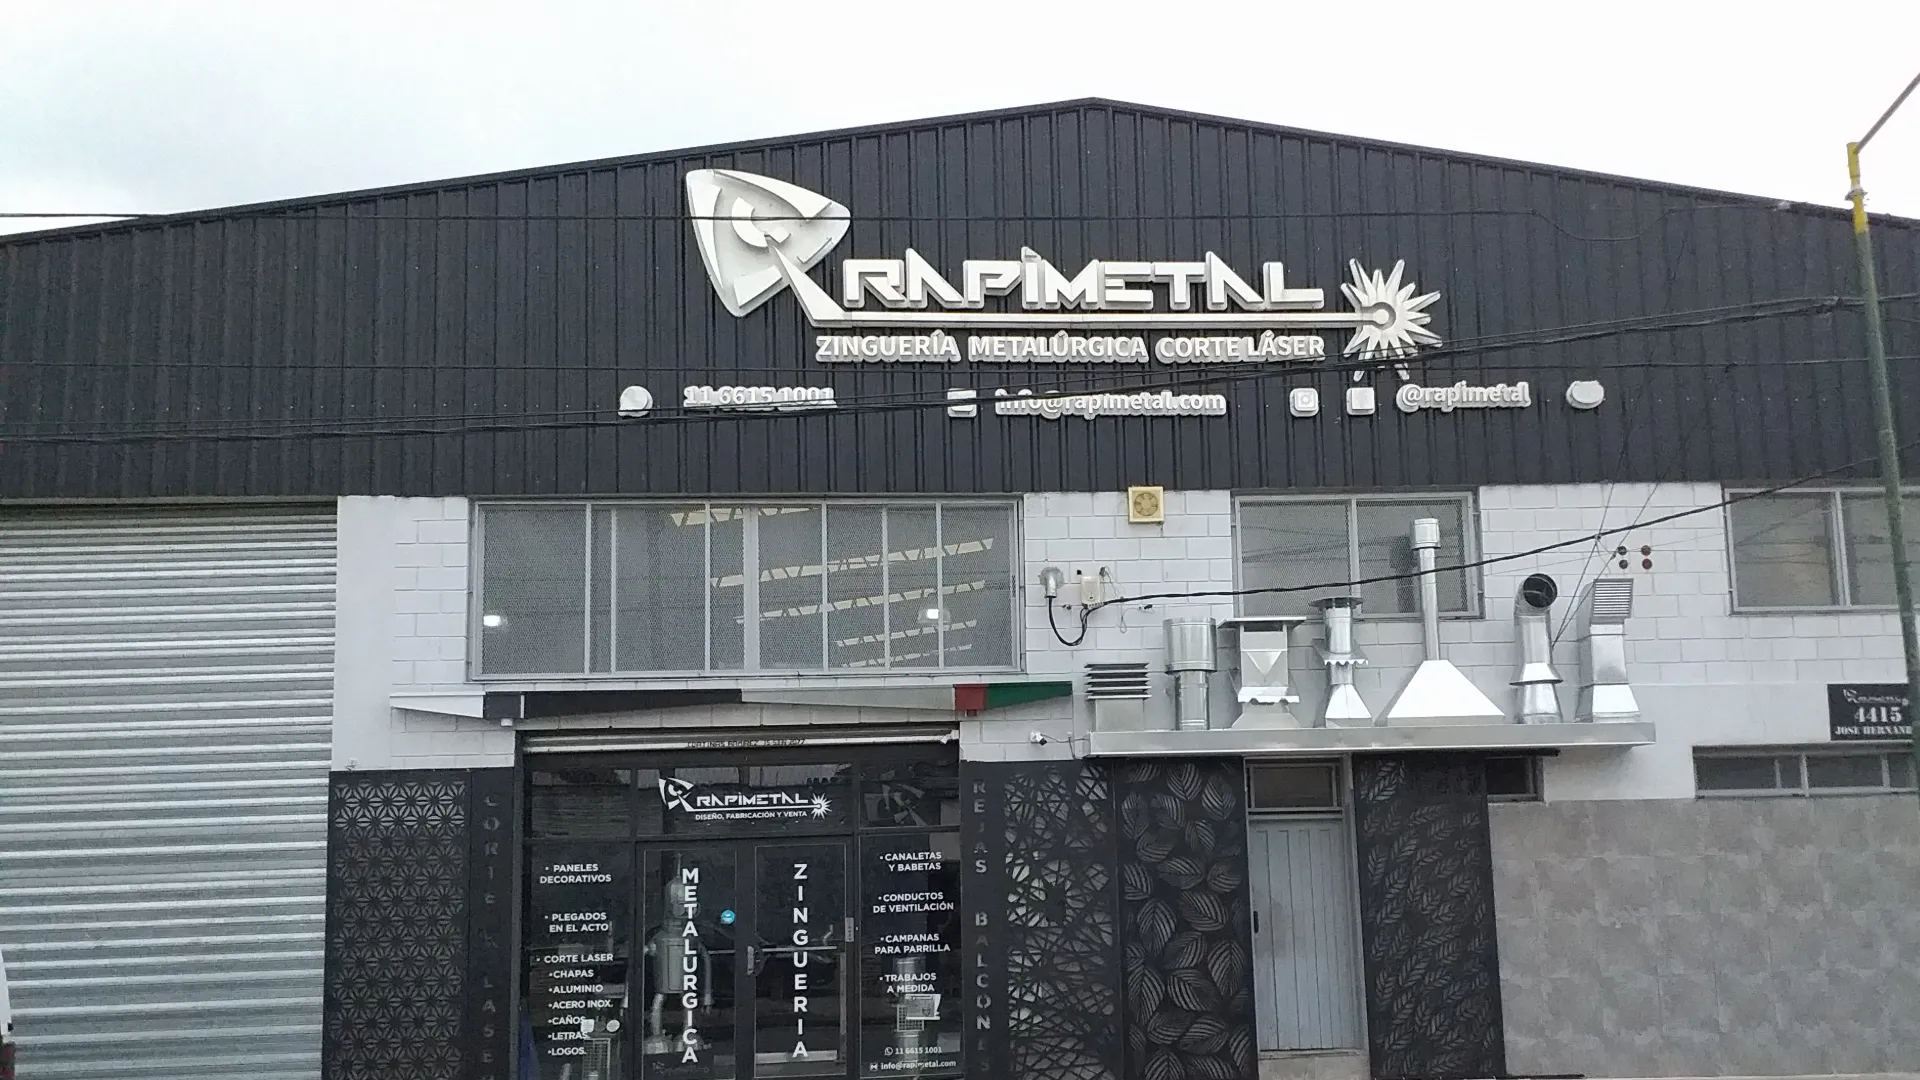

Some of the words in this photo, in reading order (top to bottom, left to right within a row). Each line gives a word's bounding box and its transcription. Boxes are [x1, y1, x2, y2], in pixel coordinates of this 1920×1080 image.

[816, 329, 961, 362] ZINGUERÍA
[968, 330, 1148, 363] METALÚRGICA
[1156, 336, 1239, 363] CORTE
[1247, 330, 1325, 361] LÁSER
[685, 386, 712, 406] 11
[719, 386, 776, 406] 6615
[779, 386, 837, 406] 1001
[1398, 381, 1531, 410] @rapimetal
[1855, 706, 1902, 722] 4415
[726, 811, 775, 820] FABRICACIÓN
[885, 852, 942, 861] CANALETAS
[553, 864, 599, 872] PANELES
[888, 864, 895, 872] Y
[898, 862, 941, 871] BABETAS
[540, 874, 612, 883] DECORATIVOS
[883, 892, 944, 902] CONDUCTOS
[873, 905, 886, 913] DE
[889, 901, 954, 912] VENTILACIÓN
[552, 912, 607, 921] PLEGADOS
[566, 924, 578, 932] EL
[581, 923, 609, 931] ACTO
[885, 933, 940, 943] CAMPANAS
[875, 946, 901, 954] PARA
[904, 944, 951, 953] PARRILLA
[544, 954, 578, 963] CORTE
[581, 953, 614, 962] LASER
[792, 863, 808, 1058] ZINGUERIA
[682, 868, 699, 1063] METALURGICA
[553, 969, 594, 979] CHAPAS
[885, 973, 937, 982] TRABAJOS
[553, 984, 604, 994] ALUMINIO
[887, 985, 894, 993] A
[897, 984, 935, 993] MEDIDA
[552, 1000, 586, 1009] ACERO
[587, 999, 614, 1008] INOX.
[552, 1047, 587, 1056] LOGOS.
[895, 1047, 903, 1055] 11
[924, 1046, 942, 1054] 1001
